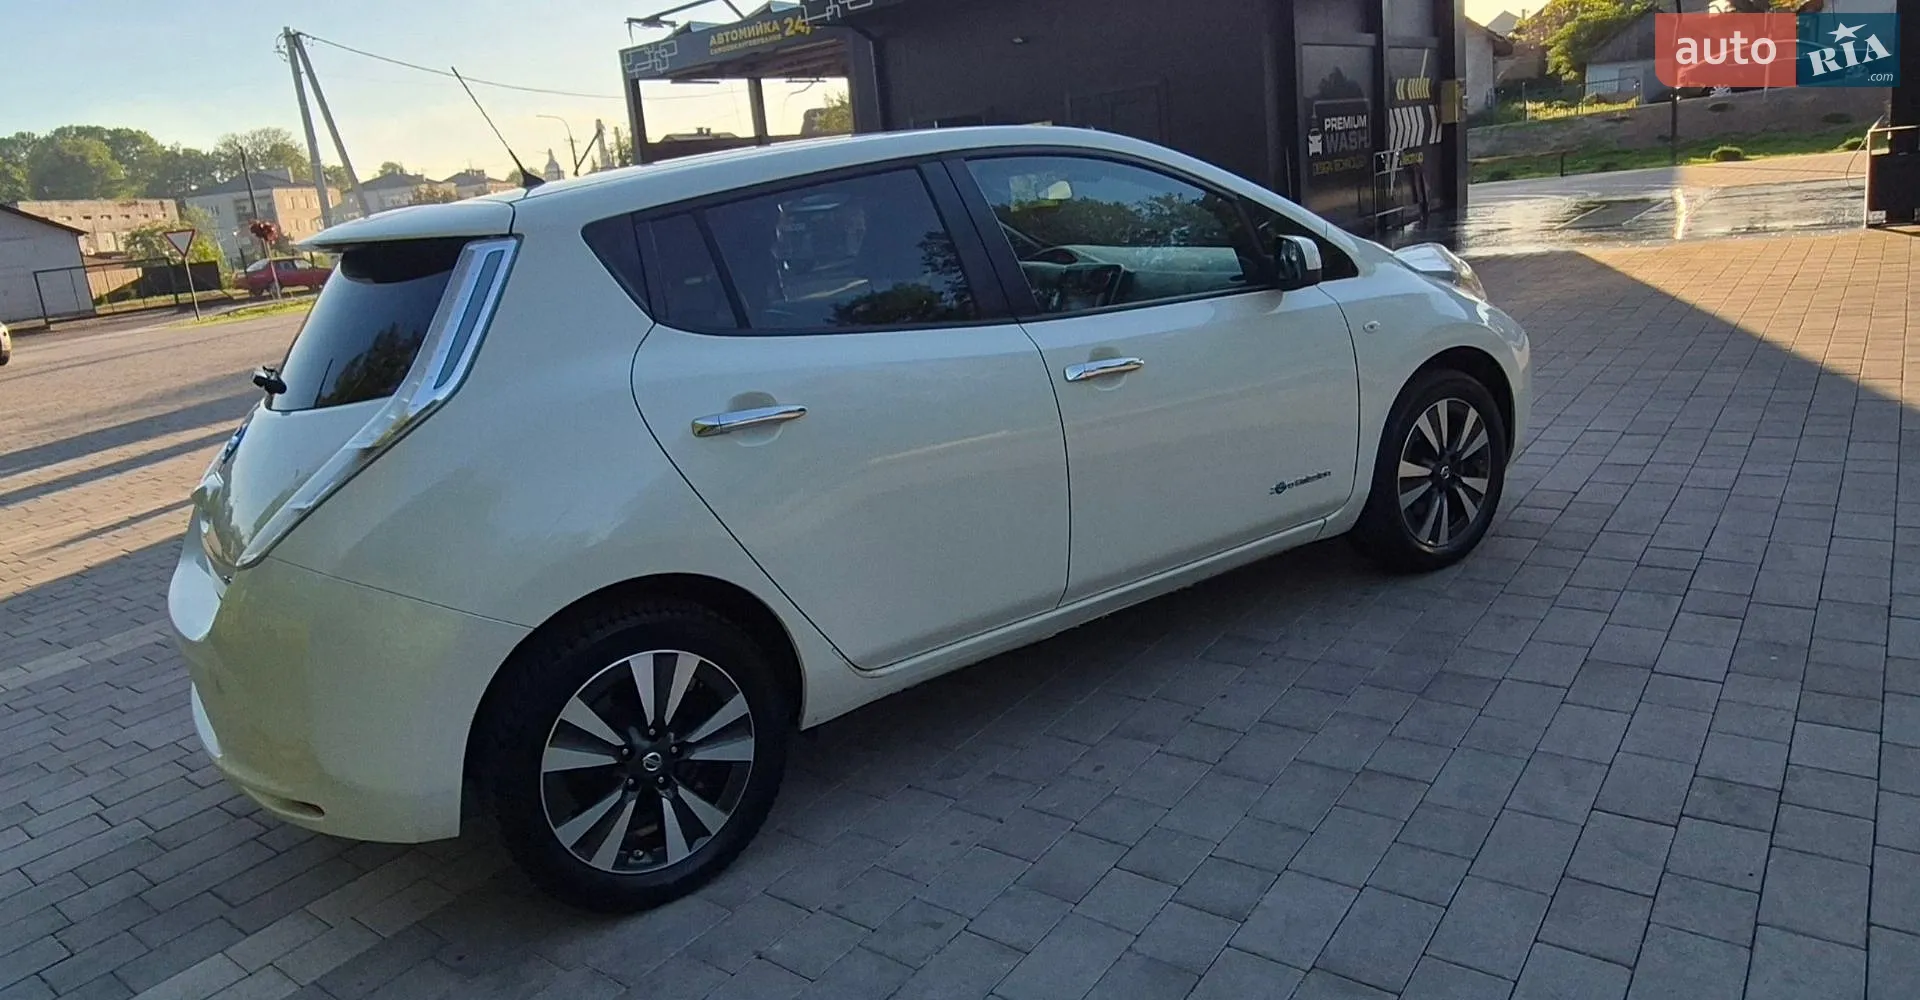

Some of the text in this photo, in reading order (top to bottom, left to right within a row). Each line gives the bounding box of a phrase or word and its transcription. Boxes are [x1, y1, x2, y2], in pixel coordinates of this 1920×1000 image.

[709, 20, 780, 47] АВТОМИЙКА
[1324, 115, 1367, 131] PREMIUM
[1326, 129, 1368, 154] WASH
